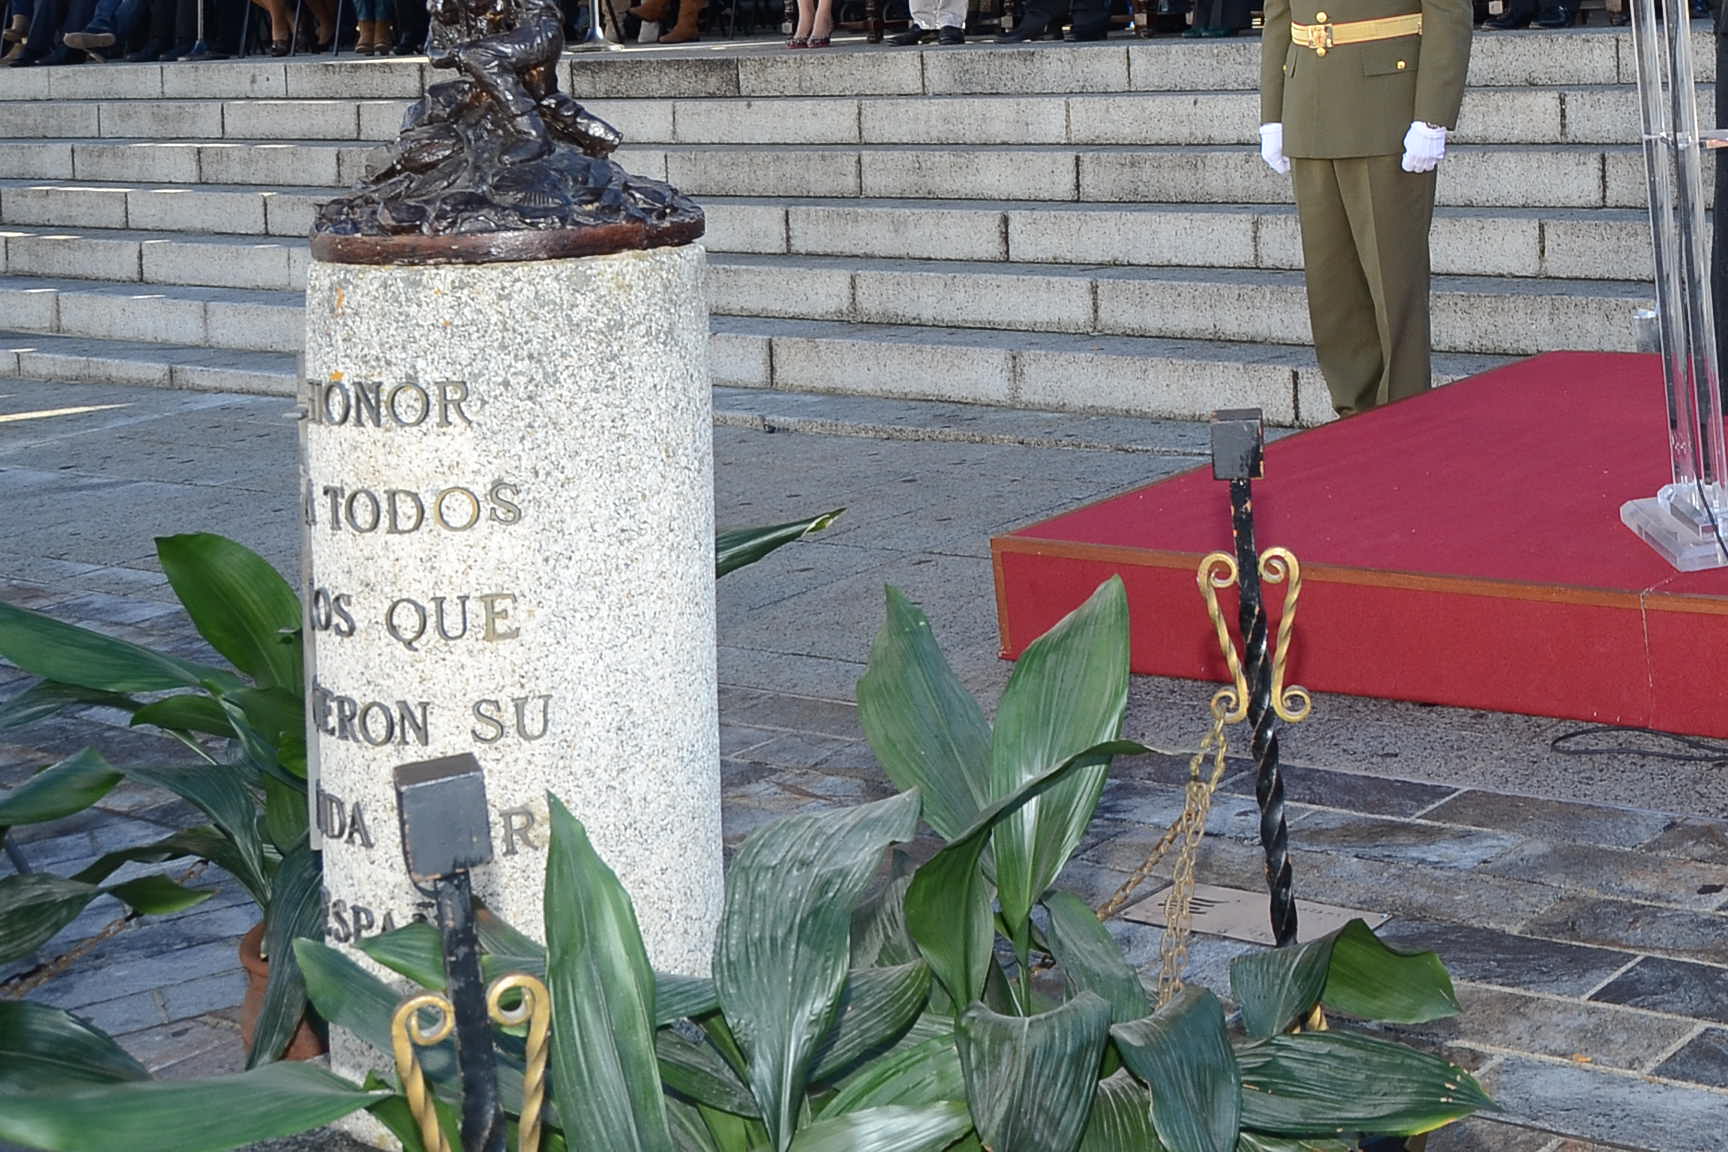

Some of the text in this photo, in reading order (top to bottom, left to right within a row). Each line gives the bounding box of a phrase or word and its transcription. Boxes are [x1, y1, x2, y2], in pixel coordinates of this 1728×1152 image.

[306, 378, 472, 427] HONOR
[323, 481, 521, 534] TODOS
[386, 593, 520, 651] QUE
[312, 680, 553, 746] ERON SU
